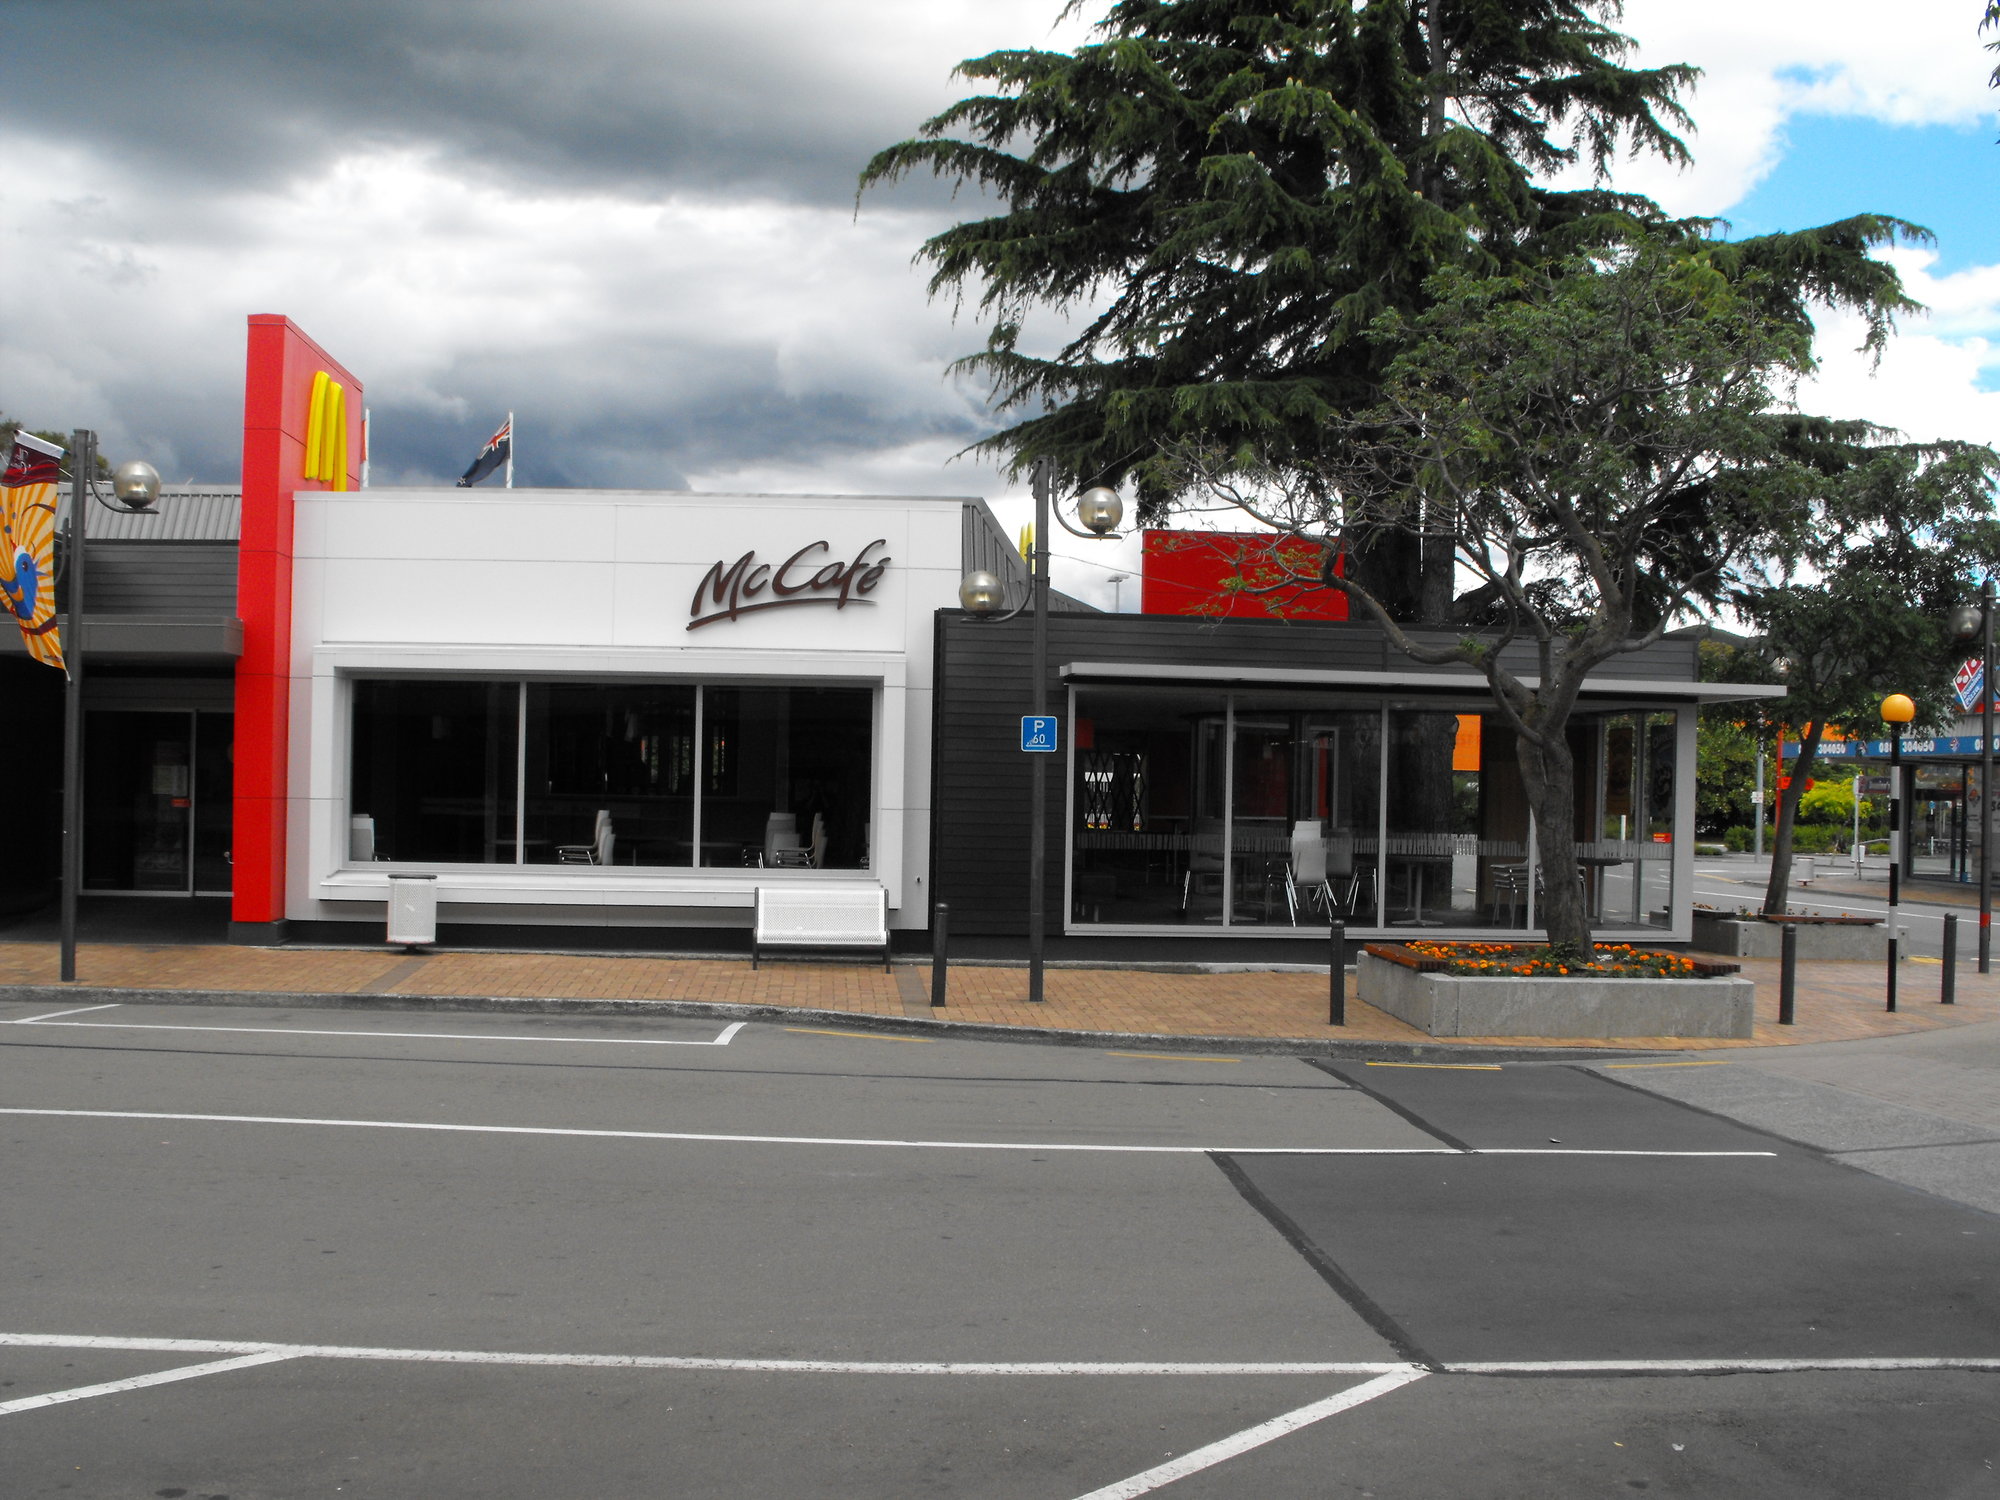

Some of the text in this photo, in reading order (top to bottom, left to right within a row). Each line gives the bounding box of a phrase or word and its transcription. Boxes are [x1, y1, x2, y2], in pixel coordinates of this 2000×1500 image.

[689, 538, 892, 624] McCafé
[1034, 720, 1045, 733] P
[1033, 733, 1046, 744] 60
[1902, 740, 1935, 752] 304050
